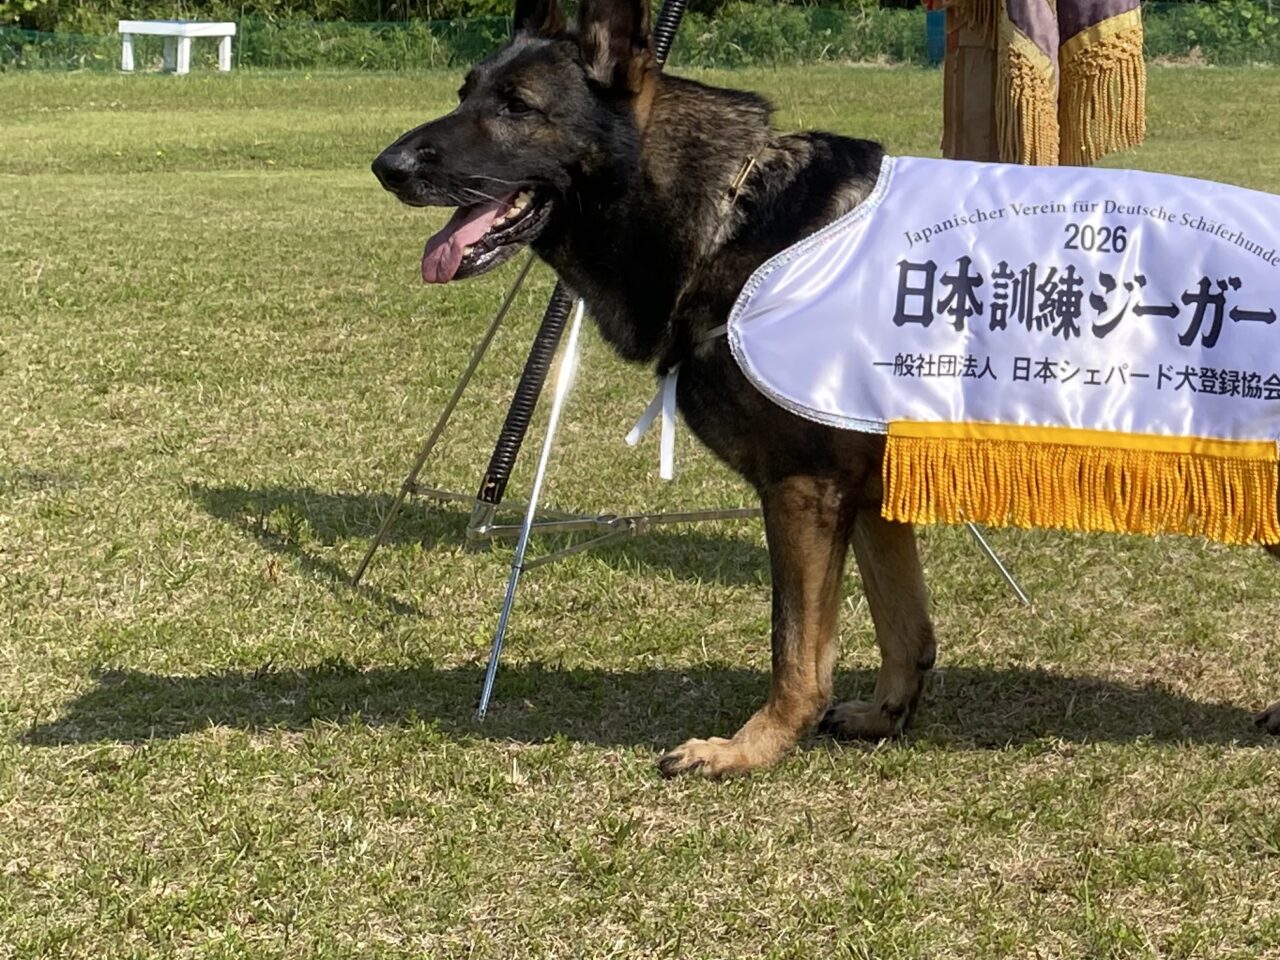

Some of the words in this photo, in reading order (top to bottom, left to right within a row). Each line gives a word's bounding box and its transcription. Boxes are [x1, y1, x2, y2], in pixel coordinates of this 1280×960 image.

[904, 208, 1006, 248] Japanischer
[1009, 201, 1067, 217] Verein
[1073, 200, 1099, 214] für
[1104, 200, 1177, 223] Deutsche
[1180, 212, 1280, 267] Schäferhunde
[1064, 223, 1128, 254] 2026
[892, 255, 1277, 349] 日本訓練ジーガー
[872, 353, 998, 382] 一般社団法人
